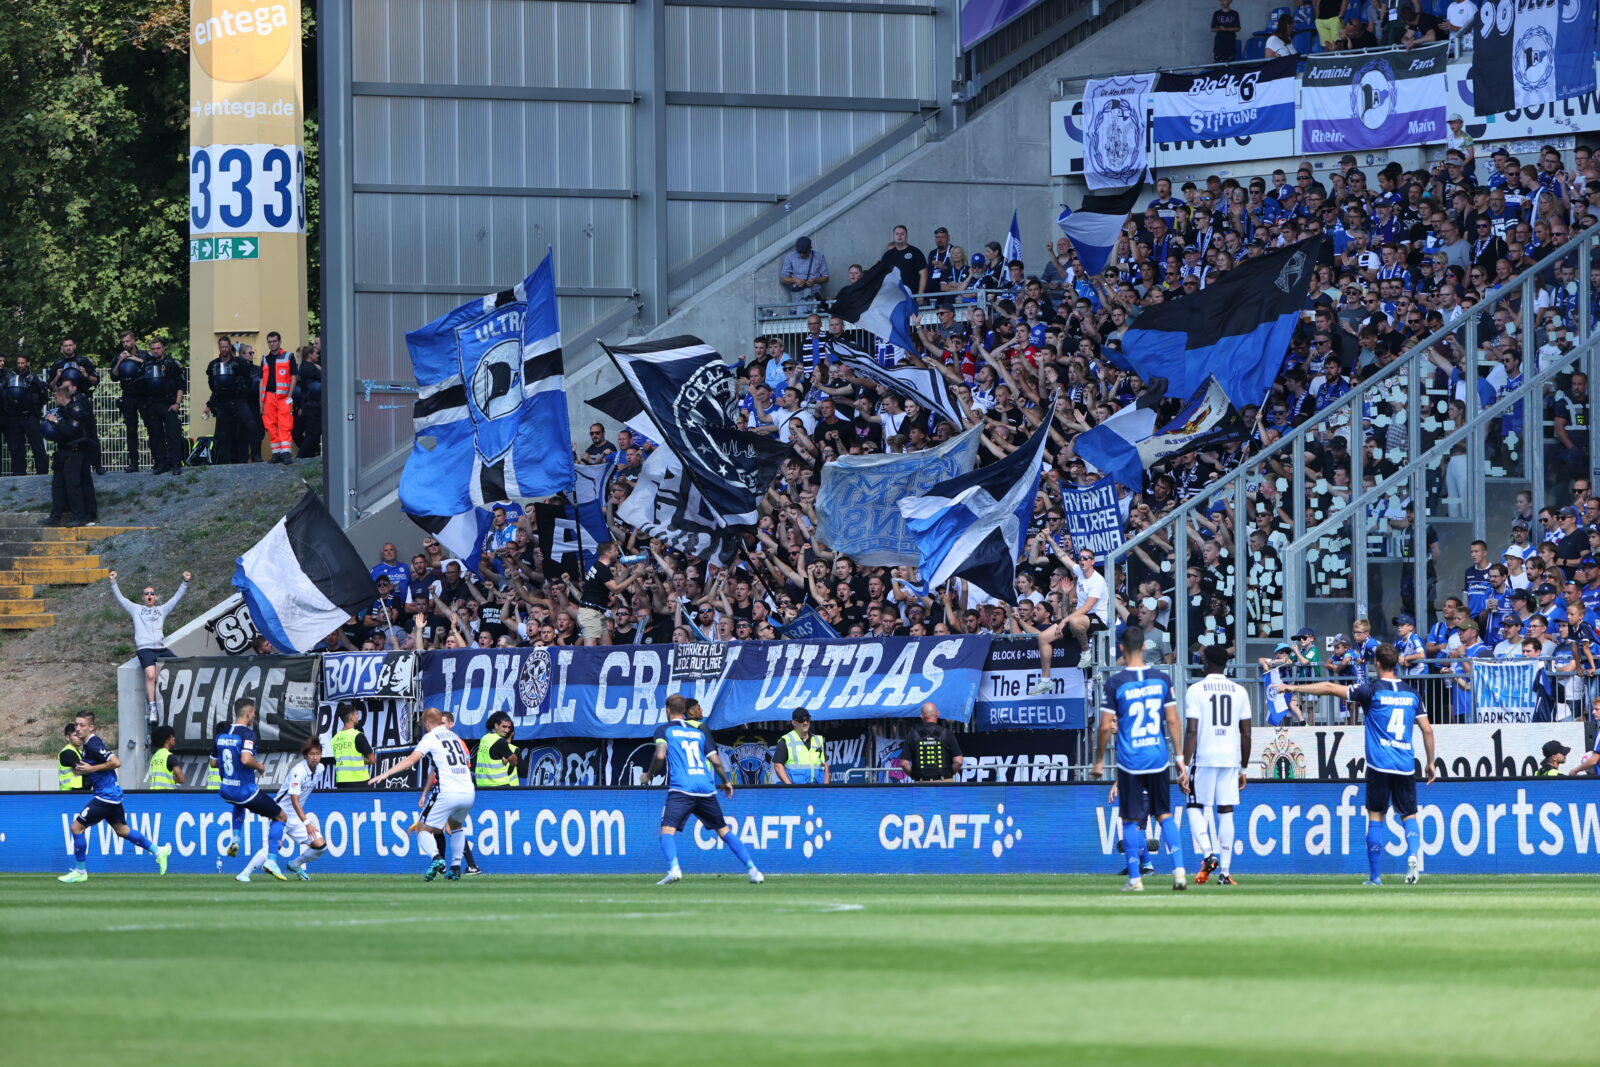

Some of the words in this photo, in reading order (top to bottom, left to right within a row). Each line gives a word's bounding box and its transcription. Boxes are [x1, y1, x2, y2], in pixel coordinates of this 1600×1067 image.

[194, 4, 288, 46] entega
[1308, 65, 1353, 81] Arminia
[1408, 56, 1436, 72] Fans
[204, 98, 295, 119] entega.de
[1311, 129, 1346, 144] Rhein-
[1408, 120, 1436, 136] Main
[1062, 484, 1115, 512] AVANTI
[1067, 507, 1119, 533] ULTRAS
[1072, 529, 1122, 556] ARMINIA
[709, 643, 724, 656] ALS
[992, 649, 1017, 661] BLOCK
[1016, 649, 1021, 660] 6
[1026, 648, 1041, 660] SIN
[1053, 648, 1065, 658] 998
[324, 655, 385, 697] BOYS
[441, 649, 577, 726] LOKL
[754, 637, 964, 712] ULTRAS
[990, 674, 1021, 697] The
[1026, 673, 1065, 696] Fm
[990, 704, 1066, 725] BIELEFELD
[1128, 698, 1162, 740] 23
[1209, 693, 1232, 727] 10
[1386, 708, 1406, 741] 4
[222, 748, 234, 777] 8
[441, 740, 467, 767] 39
[680, 740, 705, 768] 11
[693, 815, 801, 851] CRAFT
[878, 813, 990, 851] CRAFT
